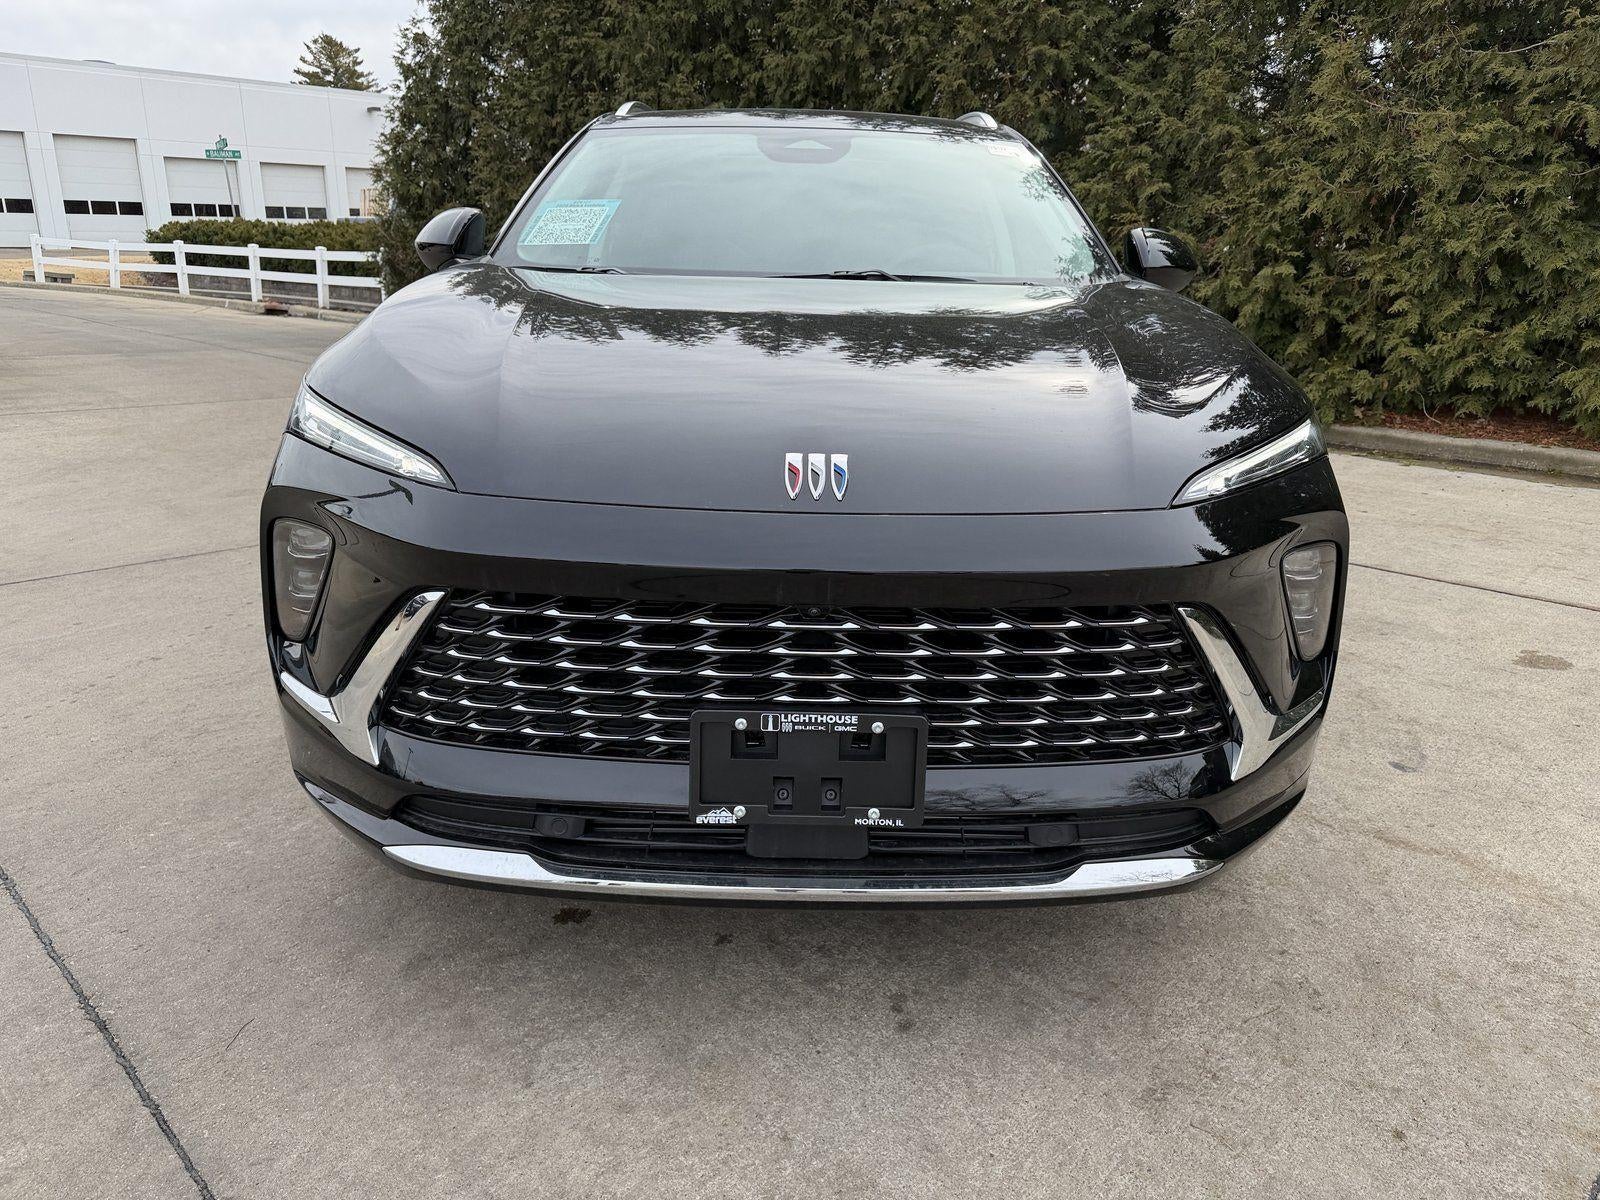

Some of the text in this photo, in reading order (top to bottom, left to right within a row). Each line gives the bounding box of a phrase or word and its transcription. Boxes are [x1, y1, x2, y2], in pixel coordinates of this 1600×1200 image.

[210, 150, 233, 158] BAUMAN
[781, 713, 859, 725] LIGHTHOUSE
[696, 815, 737, 824] everest
[854, 818, 904, 827] MORTON, IL
